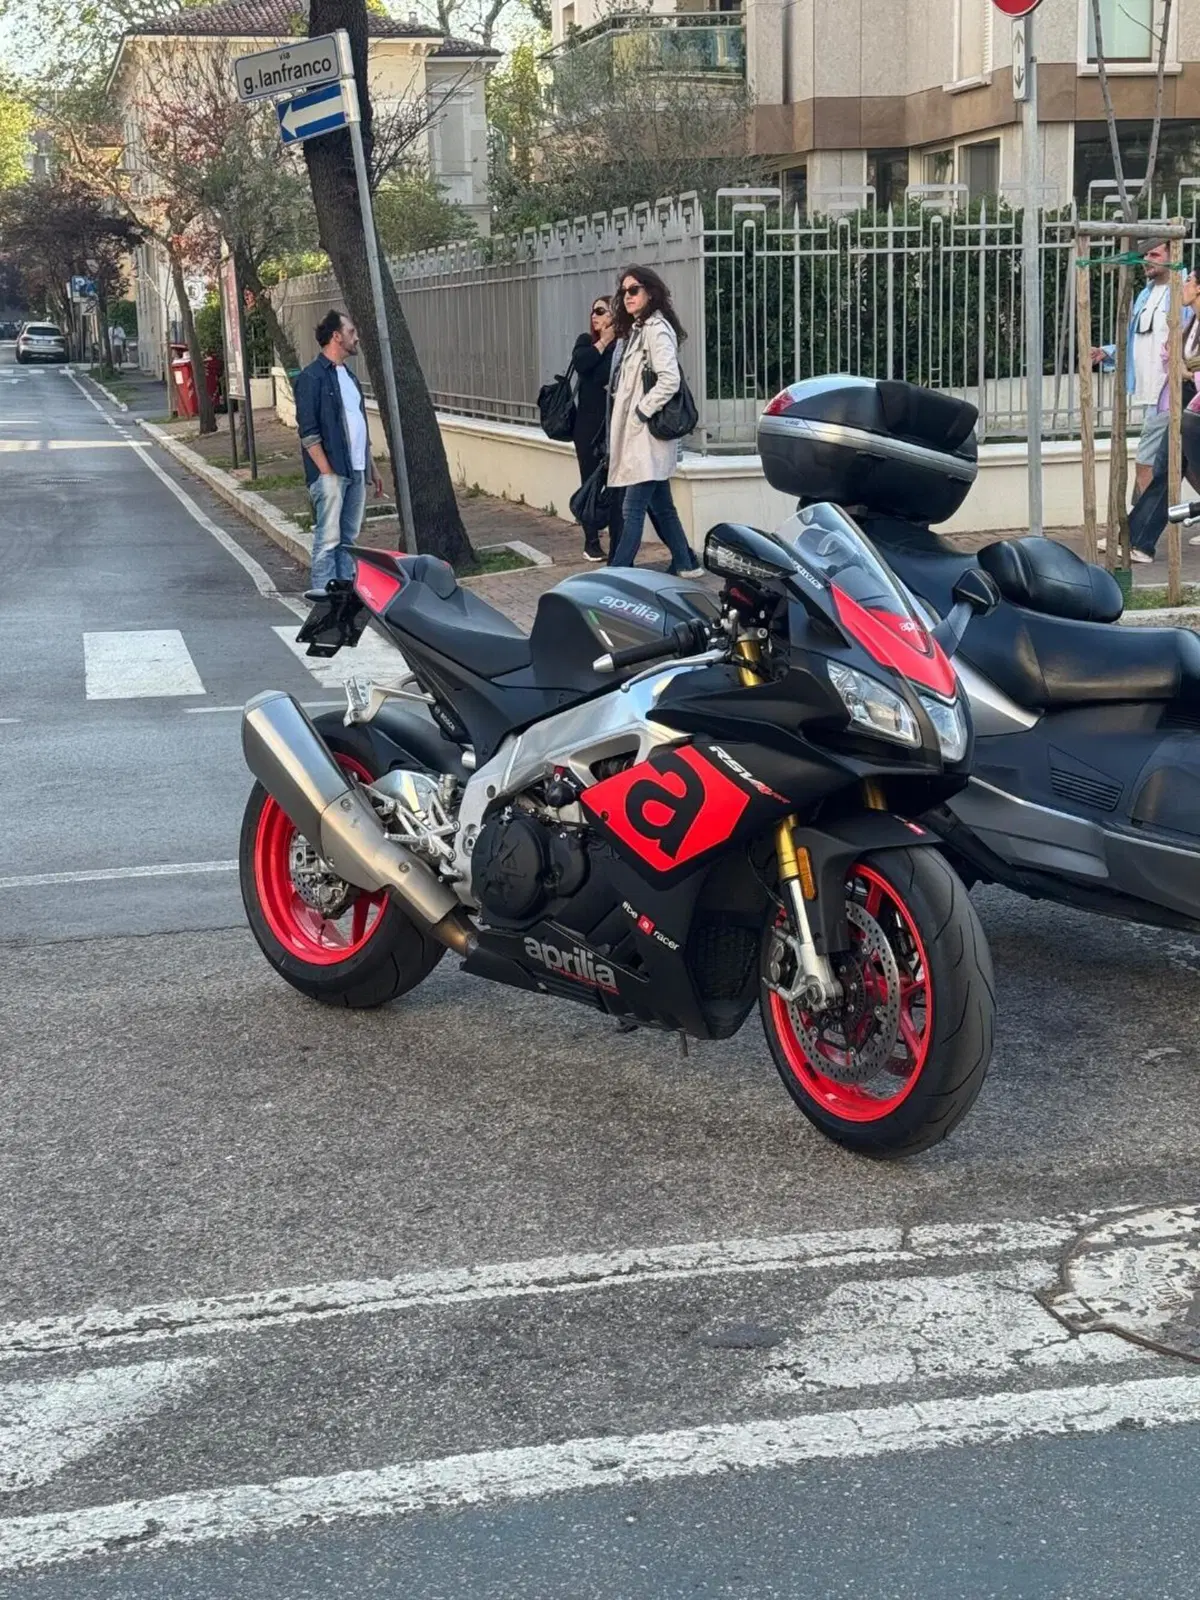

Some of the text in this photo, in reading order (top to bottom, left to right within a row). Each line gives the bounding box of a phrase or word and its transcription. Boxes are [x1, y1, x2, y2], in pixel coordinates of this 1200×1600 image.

[279, 51, 291, 61] via
[243, 57, 332, 95] g.lanfranco
[599, 595, 661, 622] aprilia
[653, 930, 680, 951] racer
[523, 936, 617, 989] aprilia
